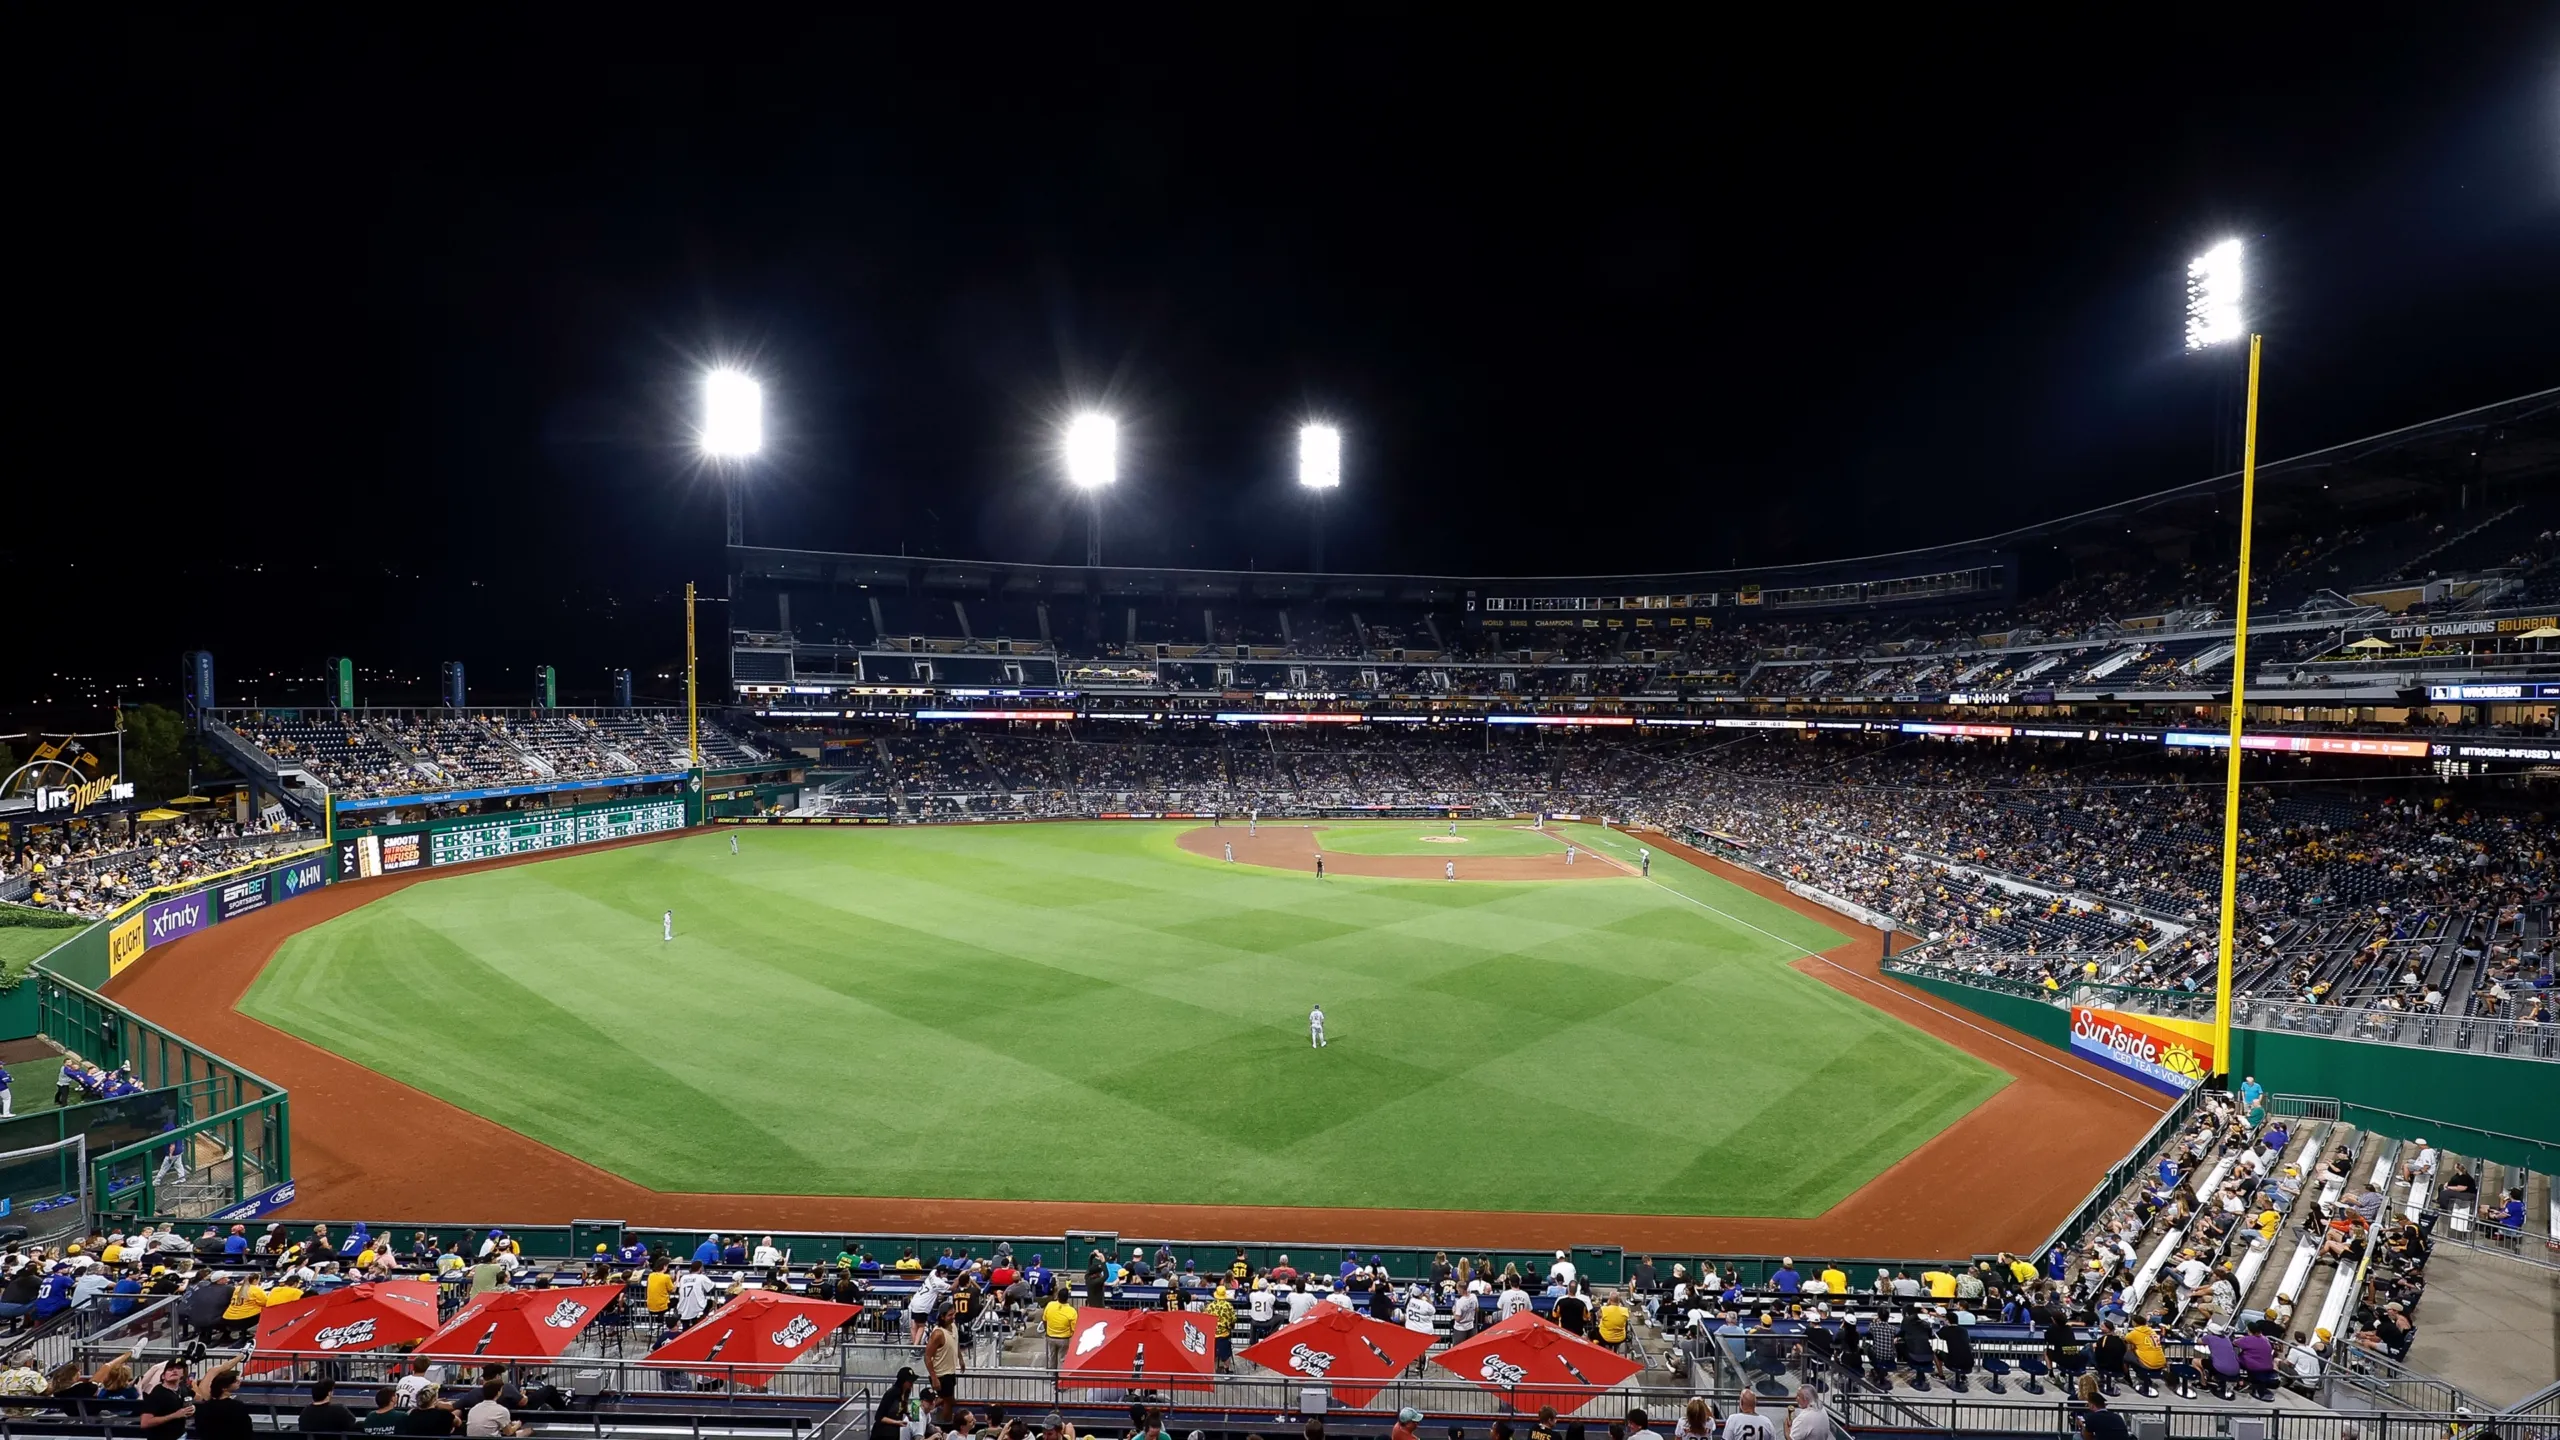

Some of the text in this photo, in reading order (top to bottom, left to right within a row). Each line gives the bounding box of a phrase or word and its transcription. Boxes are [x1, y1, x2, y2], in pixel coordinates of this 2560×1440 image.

[2390, 617, 2557, 639] CITY OF CHAMPIONS BOURBON
[2460, 747, 2550, 759] NITROGEN-INFUSED
[48, 773, 135, 814] IT'S Miller TIME
[384, 835, 419, 847] SMOOTH
[384, 844, 420, 854] NITROGEN-
[384, 850, 420, 863] INFUSED
[299, 865, 321, 889] AHN
[228, 894, 263, 910] SPORTSBOOK
[152, 903, 200, 938] xfinity
[122, 925, 142, 957] LIGHT
[2075, 1009, 2156, 1063] Surfside
[2113, 1050, 2133, 1066] ICED
[2134, 1060, 2152, 1077] TEA
[342, 1240, 356, 1251] 17
[625, 1251, 632, 1259] 8
[683, 1285, 694, 1298] 17
[544, 1298, 578, 1327] Coca-Cola
[954, 1300, 968, 1313] 10
[1254, 1301, 1267, 1312] 21
[1408, 1309, 1421, 1323] 25
[315, 1317, 378, 1342] Coca-Cola
[771, 1313, 811, 1345] Coca-Cola
[792, 1324, 819, 1345] Patio
[333, 1333, 374, 1348] Patio
[1291, 1343, 1336, 1369] Coca-Cola
[1297, 1361, 1324, 1378] Patio
[1483, 1354, 1528, 1381] Coca-Cola
[1742, 1425, 1764, 1440] 21
